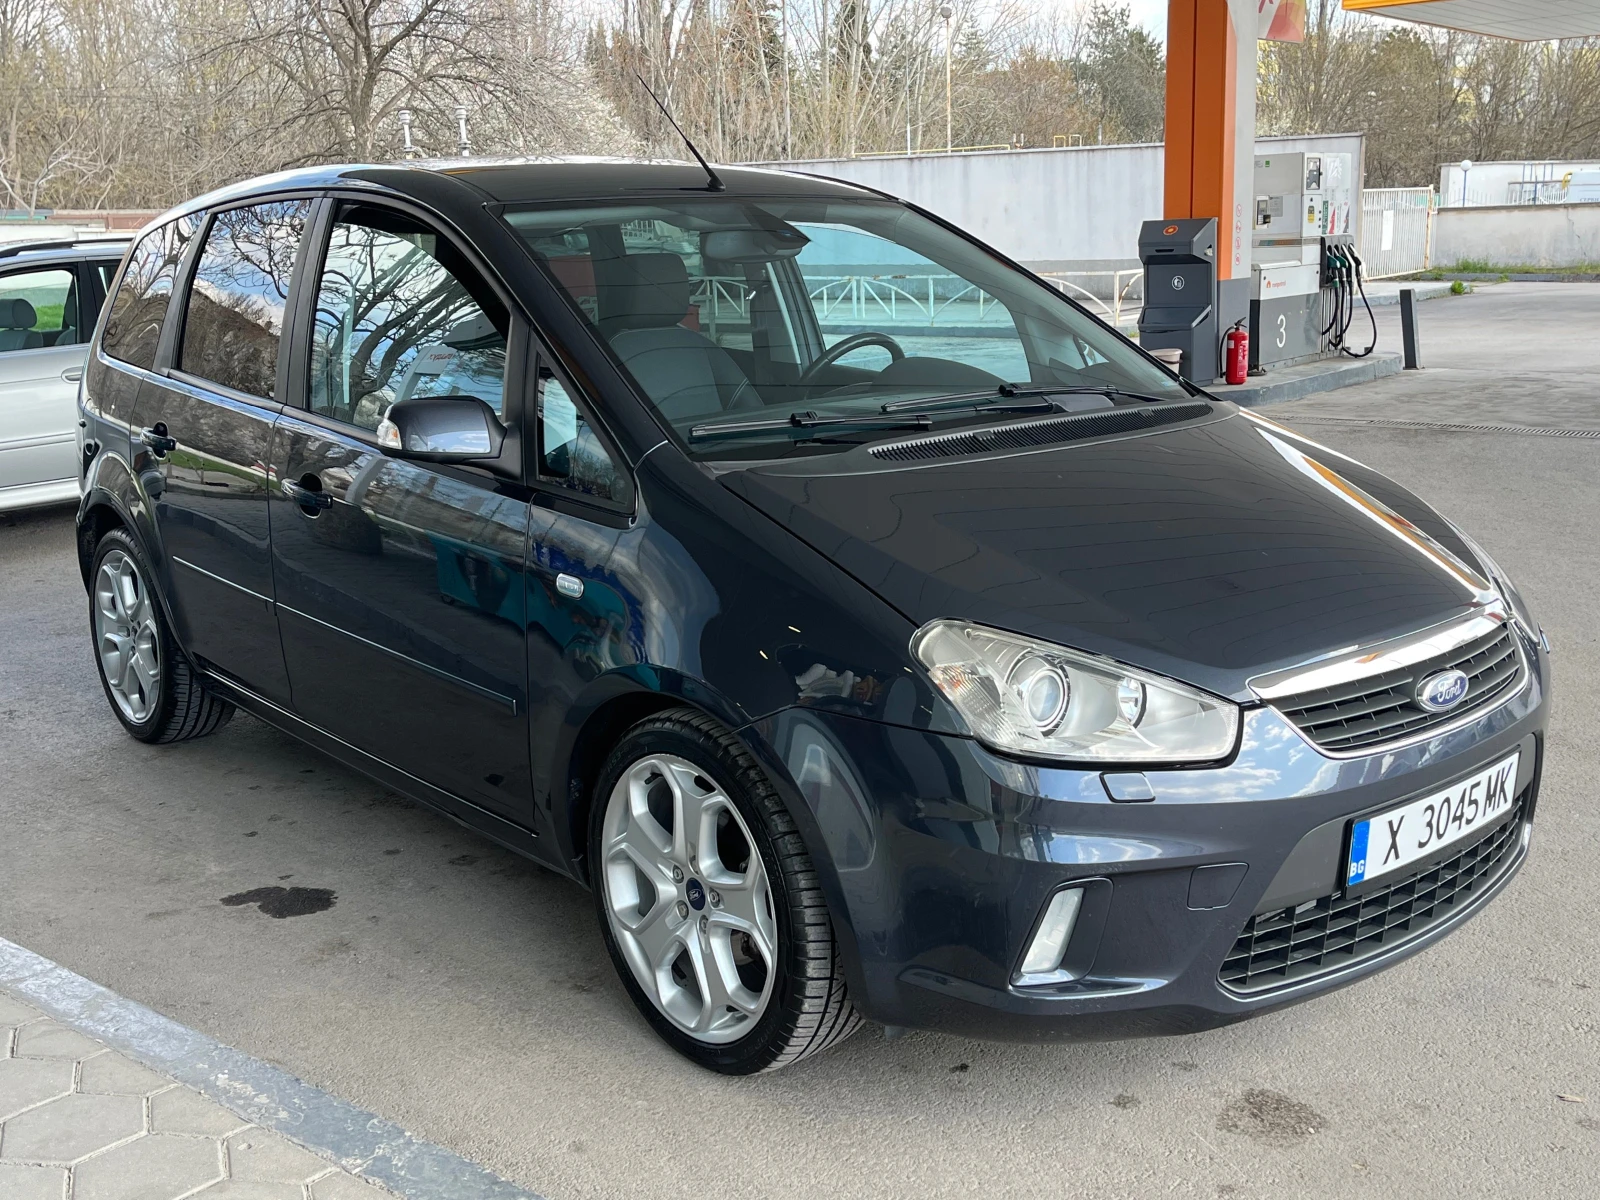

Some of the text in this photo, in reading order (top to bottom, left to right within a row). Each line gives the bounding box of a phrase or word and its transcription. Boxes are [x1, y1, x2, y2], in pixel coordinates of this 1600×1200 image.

[1276, 314, 1287, 348] 3
[1437, 679, 1462, 703] Ford
[1382, 762, 1513, 866] X 3045 MK
[1349, 859, 1365, 878] BG
